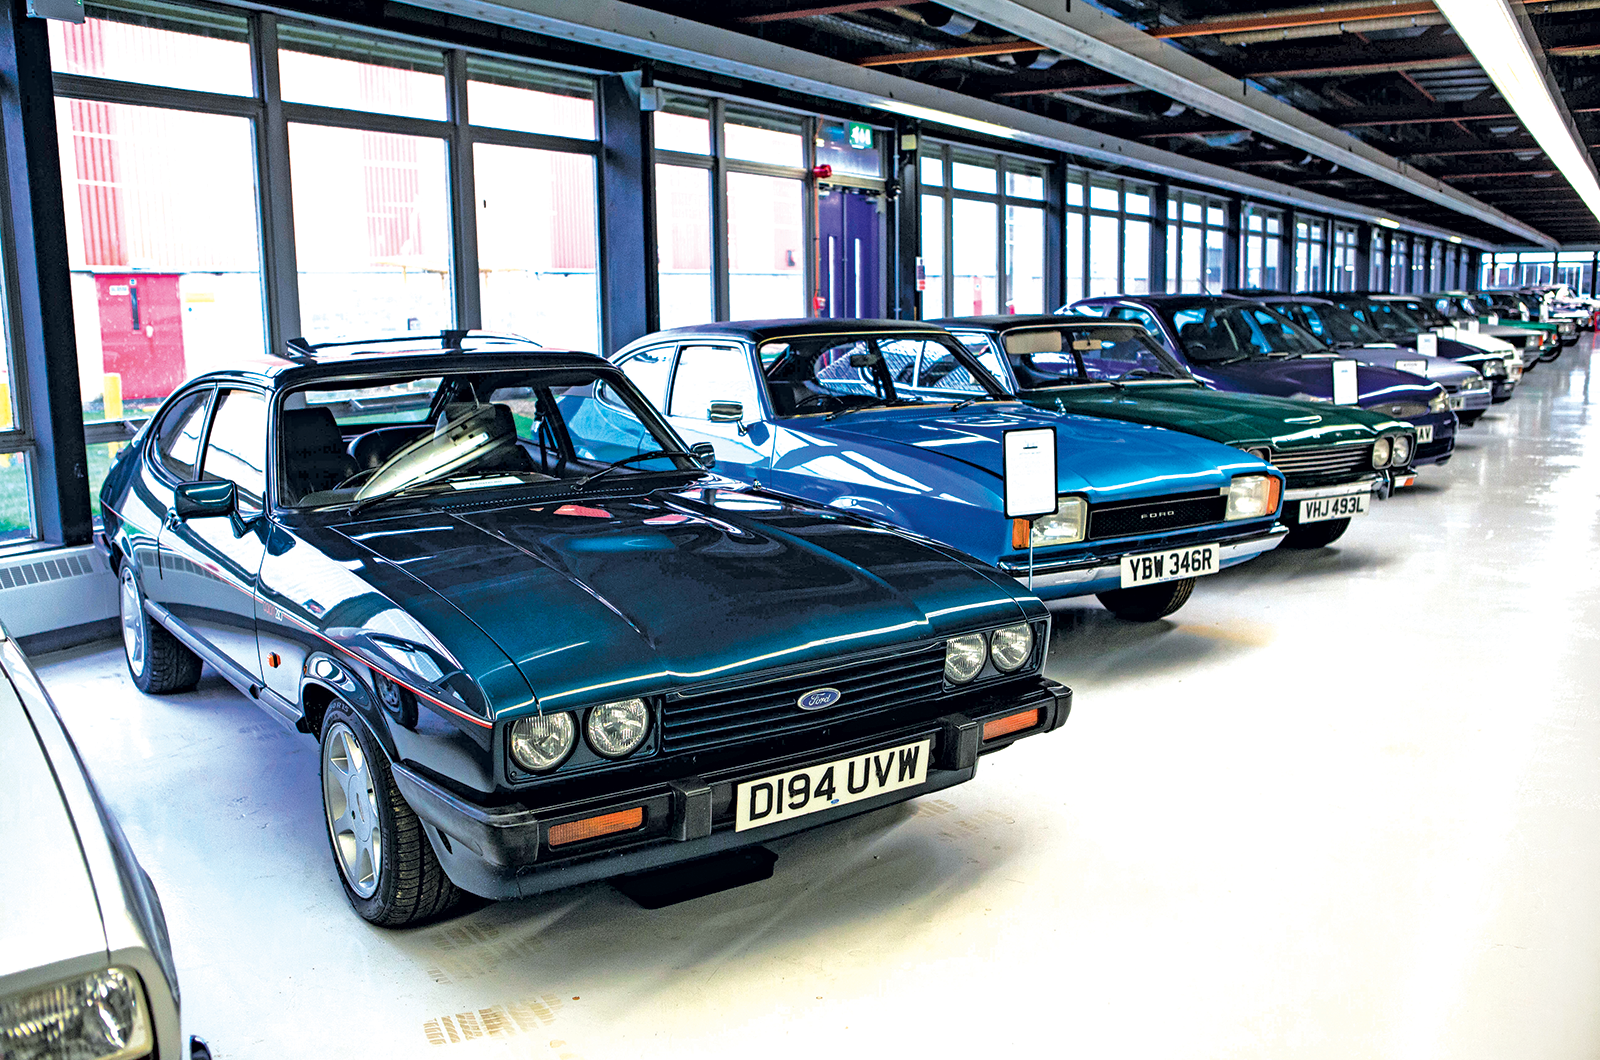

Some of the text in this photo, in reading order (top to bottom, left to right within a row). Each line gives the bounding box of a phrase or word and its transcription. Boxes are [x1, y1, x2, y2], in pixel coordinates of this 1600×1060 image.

[1141, 510, 1175, 519] FORD
[1306, 496, 1364, 519] VHJ 493L
[1129, 548, 1212, 581] YBW 346R
[808, 692, 832, 706] Ford
[749, 745, 920, 821] D194 UVW
